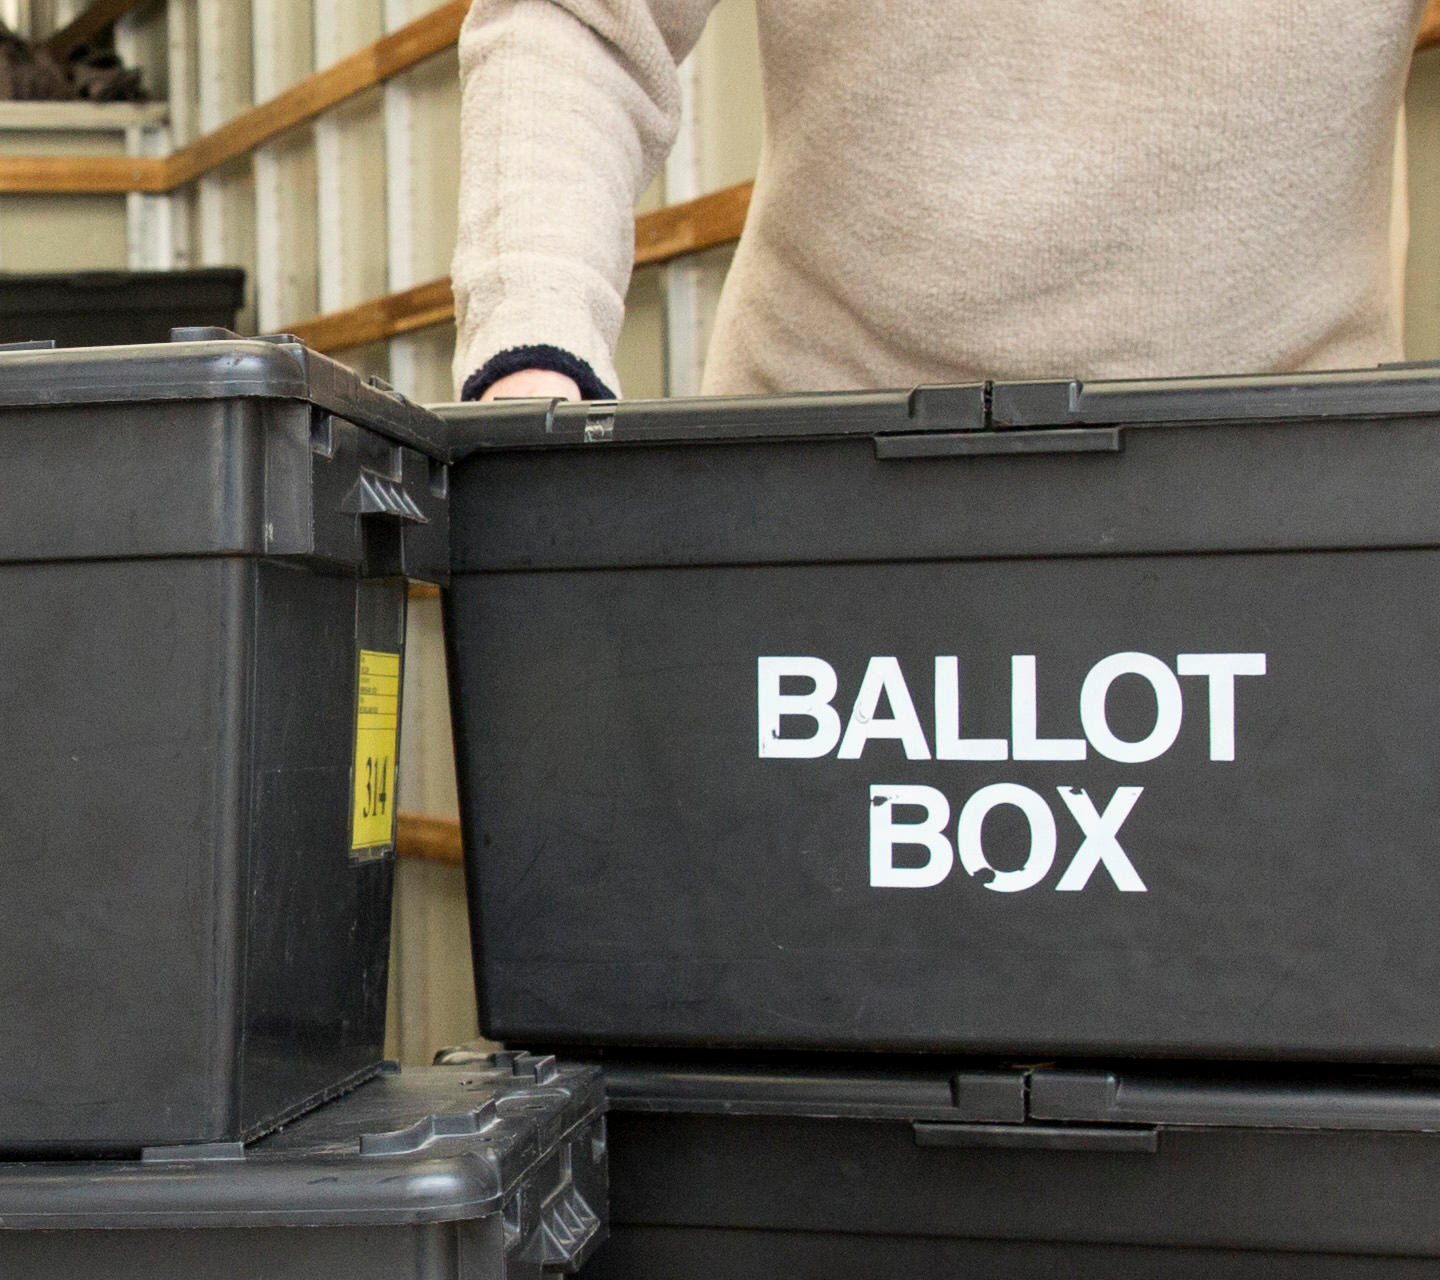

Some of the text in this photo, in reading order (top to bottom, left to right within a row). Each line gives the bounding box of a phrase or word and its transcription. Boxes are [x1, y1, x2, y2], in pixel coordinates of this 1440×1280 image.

[758, 652, 1266, 763] BALLOT
[362, 754, 389, 819] 314
[870, 783, 1147, 892] BOX
